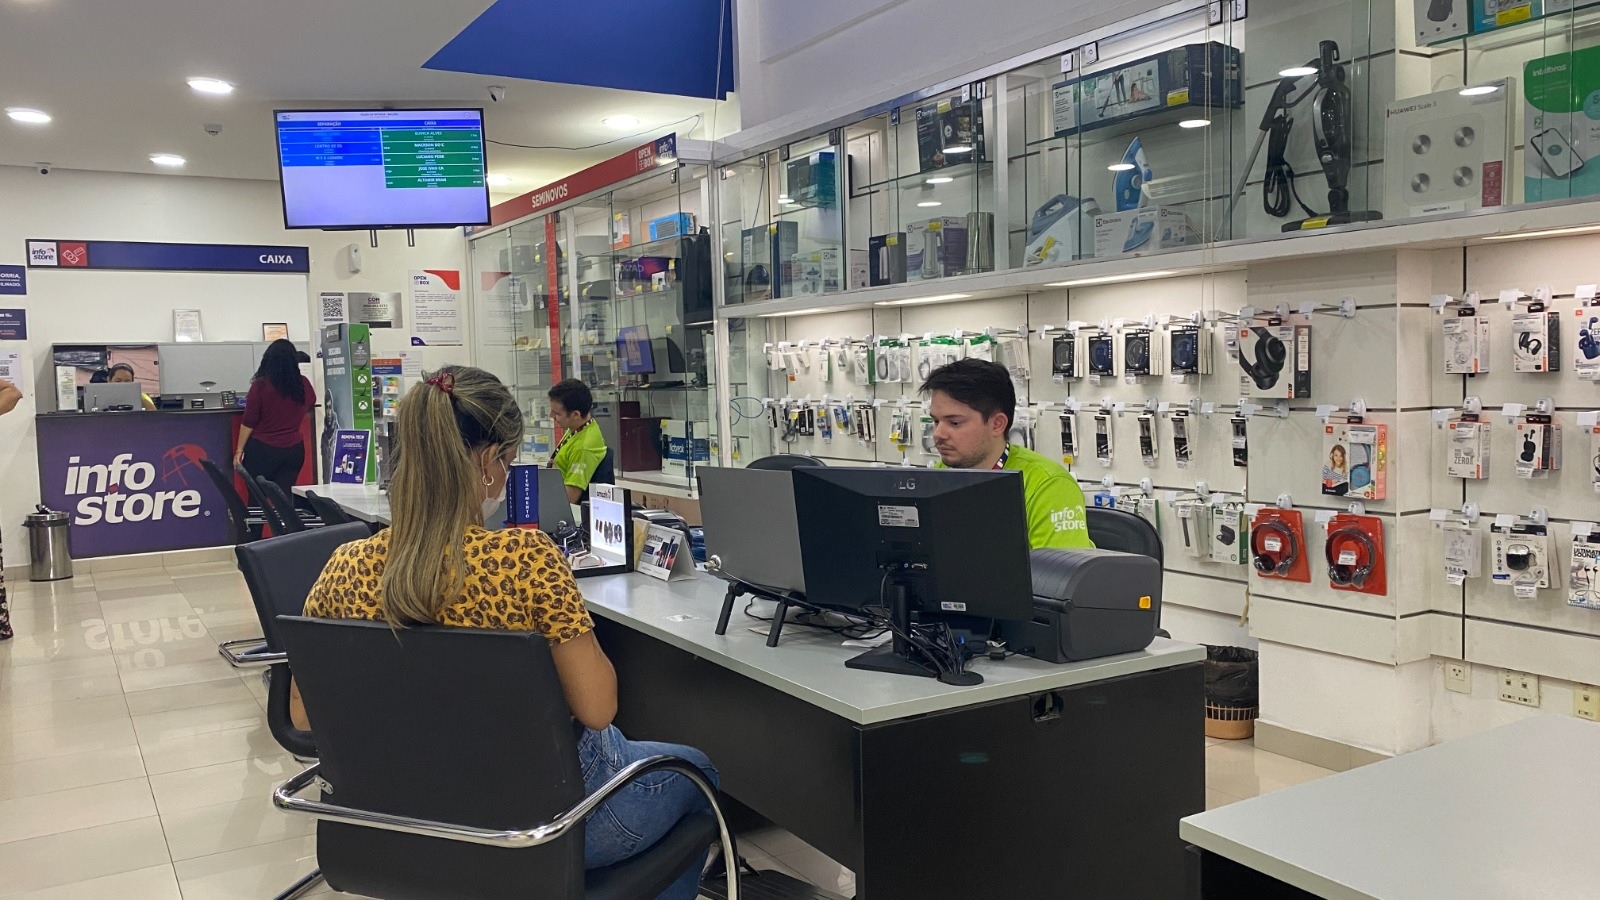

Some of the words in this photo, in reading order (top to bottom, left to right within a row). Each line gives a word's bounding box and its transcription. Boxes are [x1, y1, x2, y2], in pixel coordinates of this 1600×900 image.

[1390, 105, 1417, 115] HUAWEI
[531, 183, 568, 208] SEMINOVOS
[259, 254, 294, 265] CAIXA
[1454, 456, 1470, 465] ZERO
[64, 453, 156, 496] info
[898, 478, 916, 490] LG
[74, 489, 202, 526] store
[1050, 506, 1075, 523] info
[1053, 519, 1086, 532] store
